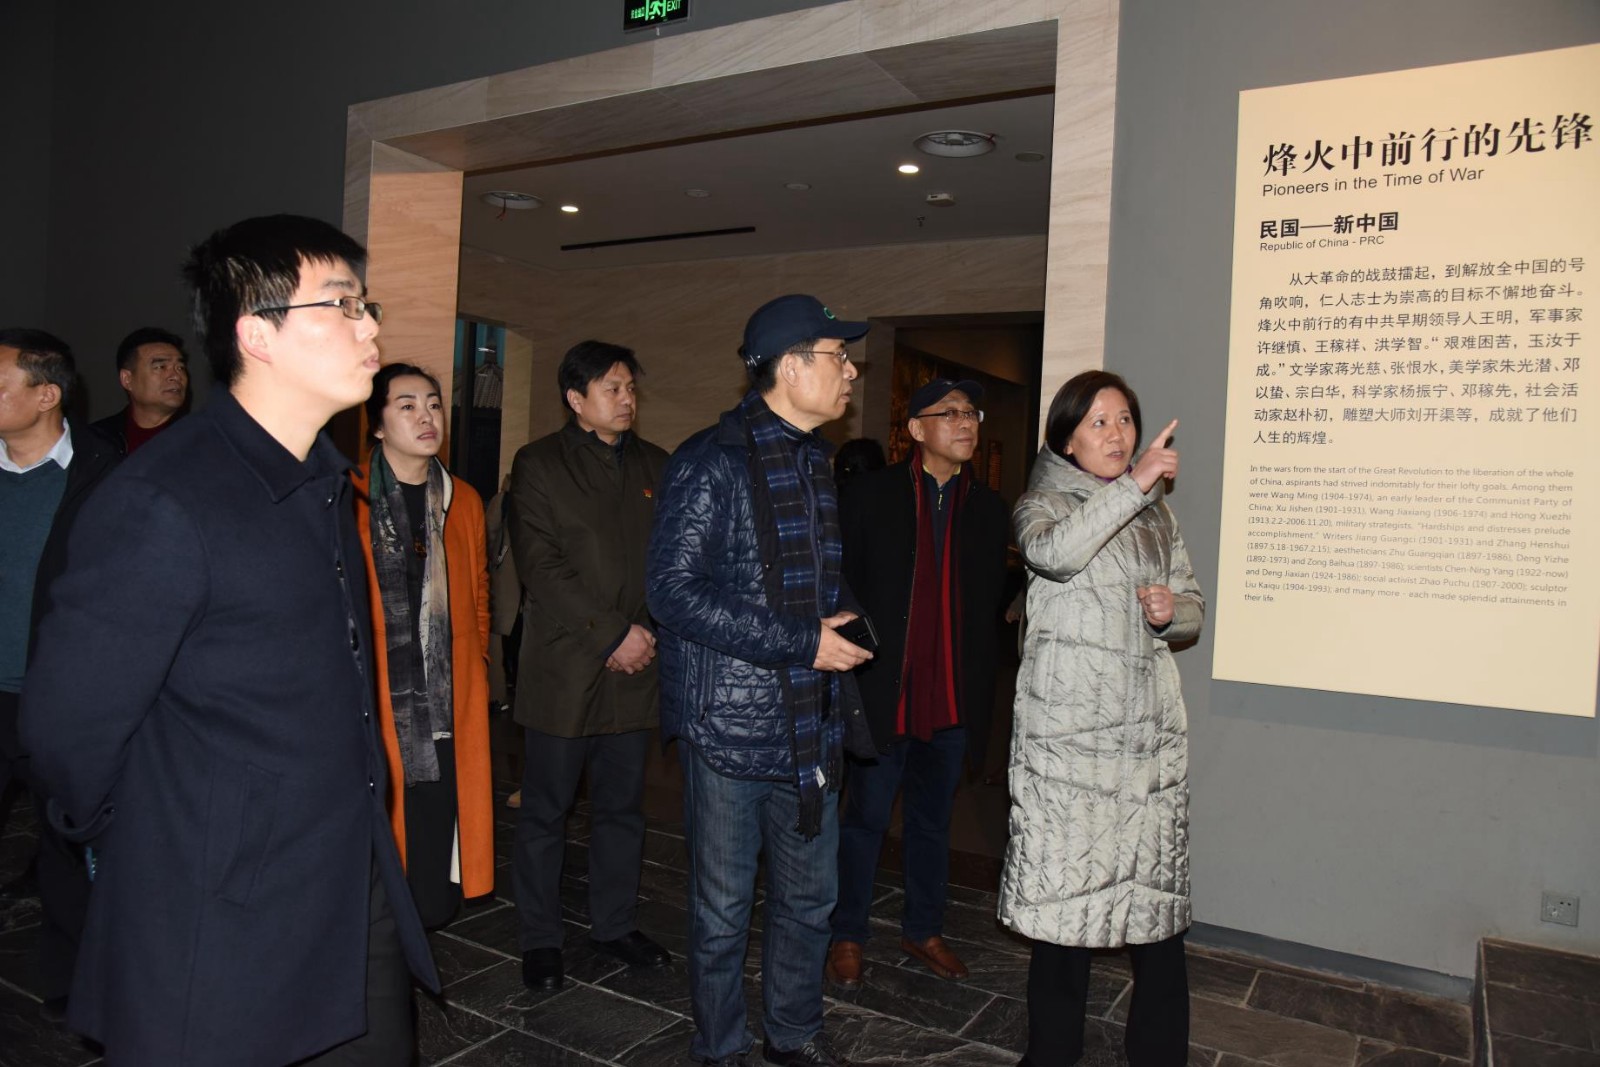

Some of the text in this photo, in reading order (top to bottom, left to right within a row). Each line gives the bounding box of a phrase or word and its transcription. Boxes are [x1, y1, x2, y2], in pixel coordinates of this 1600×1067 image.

[667, 0, 681, 12] EXIT
[1263, 112, 1594, 177] 烽火中前行的先锋
[1262, 168, 1484, 196] Pioneers in the Time of War
[1260, 241, 1303, 252] Republic
[1306, 239, 1316, 248] of
[1319, 238, 1348, 248] China
[1360, 235, 1384, 245] PRC
[1254, 430, 1334, 445] 人生的辉煌。
[1398, 466, 1442, 474] Revolution
[1472, 467, 1514, 475] liberation
[1545, 468, 1573, 476] whole
[1286, 478, 1320, 487] aspirants
[1370, 479, 1421, 490] indomitably
[1458, 481, 1479, 491] lofty
[1511, 482, 1545, 492] Among
[1548, 483, 1572, 491] them
[1270, 491, 1294, 500] Wang
[1296, 491, 1318, 501] Ming
[1390, 493, 1412, 503] early
[1414, 494, 1444, 502] leader
[1476, 495, 1530, 504] Communist
[1533, 496, 1558, 507] Party
[1369, 506, 1394, 516] Wang
[1395, 507, 1430, 517] Jiaxiang
[1433, 508, 1487, 518] (1906-1974)
[1490, 510, 1507, 518] and
[1510, 510, 1536, 520] Hong
[1539, 511, 1571, 519] Xuezhi
[1336, 519, 1366, 529] military
[1467, 523, 1484, 531] and
[1486, 523, 1531, 532] distresses
[1534, 525, 1570, 536] prelude
[1322, 531, 1352, 540] Writers
[1355, 533, 1377, 543] Jiang
[1380, 534, 1415, 544] Guangci
[1418, 535, 1473, 546] (1901-1931)
[1476, 537, 1493, 545] and
[1496, 538, 1526, 548] Zhang
[1528, 539, 1569, 548] Henshui
[1333, 545, 1386, 555] aestheticians
[1388, 548, 1405, 556] Zhu
[1408, 548, 1454, 560] Guangqian
[1516, 553, 1541, 564] Deng
[1544, 554, 1568, 563] Yizhe
[1246, 555, 1289, 565] (1892-1973)
[1307, 558, 1326, 567] Zong
[1328, 558, 1354, 567] Baihua
[1407, 562, 1443, 571] scientists
[1492, 566, 1514, 576] Yang
[1516, 567, 1568, 578] (1922-now)
[1262, 568, 1282, 578] Deng
[1284, 569, 1309, 578] Jiaxian
[1363, 573, 1386, 582] social
[1388, 574, 1416, 583] activist
[1419, 576, 1440, 584] Zhao
[1442, 577, 1469, 586] Puchu
[1530, 582, 1566, 593] sculptor
[1333, 585, 1350, 593] and
[1352, 588, 1375, 596] many
[1408, 589, 1428, 598] each
[1431, 590, 1456, 599] made
[1458, 592, 1497, 604] splendid
[1500, 594, 1554, 605] attainments
[1557, 597, 1566, 606] in
